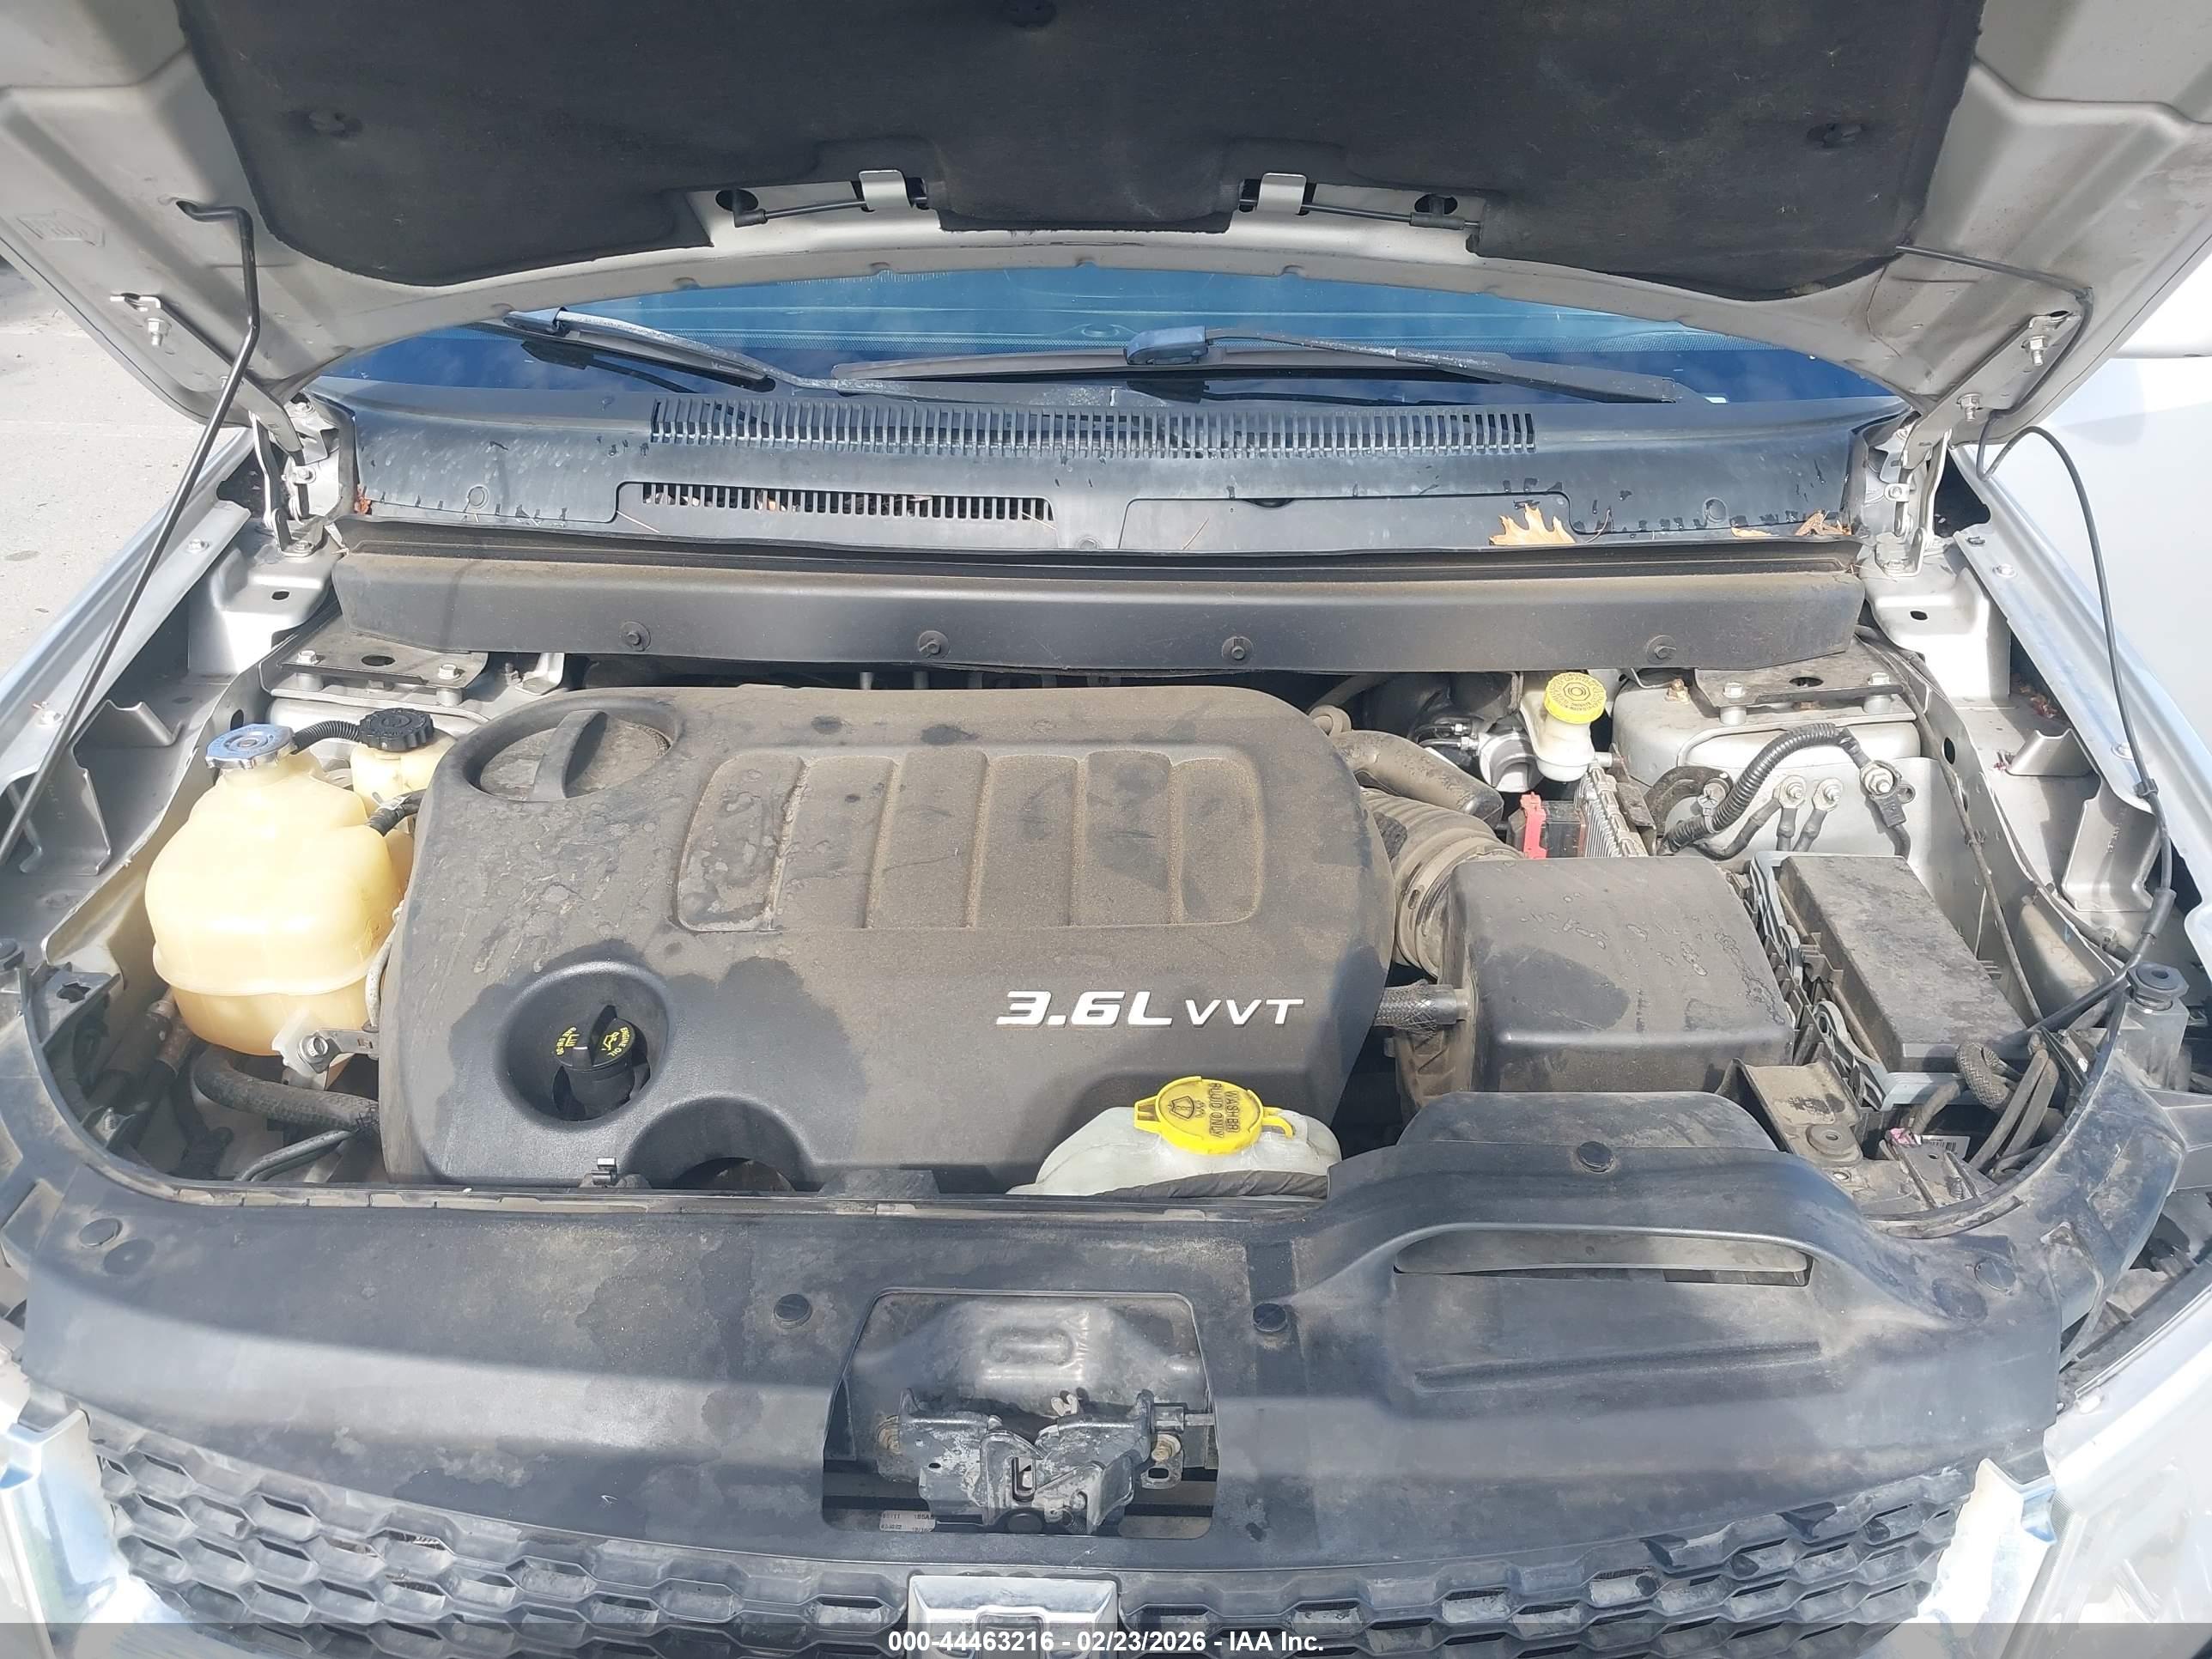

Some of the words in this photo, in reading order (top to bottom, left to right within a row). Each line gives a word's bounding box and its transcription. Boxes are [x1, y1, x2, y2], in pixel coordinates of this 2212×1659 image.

[995, 990, 1173, 1028] 3.6L
[1185, 999, 1305, 1028] VVT
[619, 1026, 630, 1048] ENGINE
[606, 1048, 623, 1057] OIL
[1208, 1082, 1223, 1111] FLUID
[1209, 1112, 1224, 1138] ONLY
[1224, 1090, 1241, 1133] WASHER
